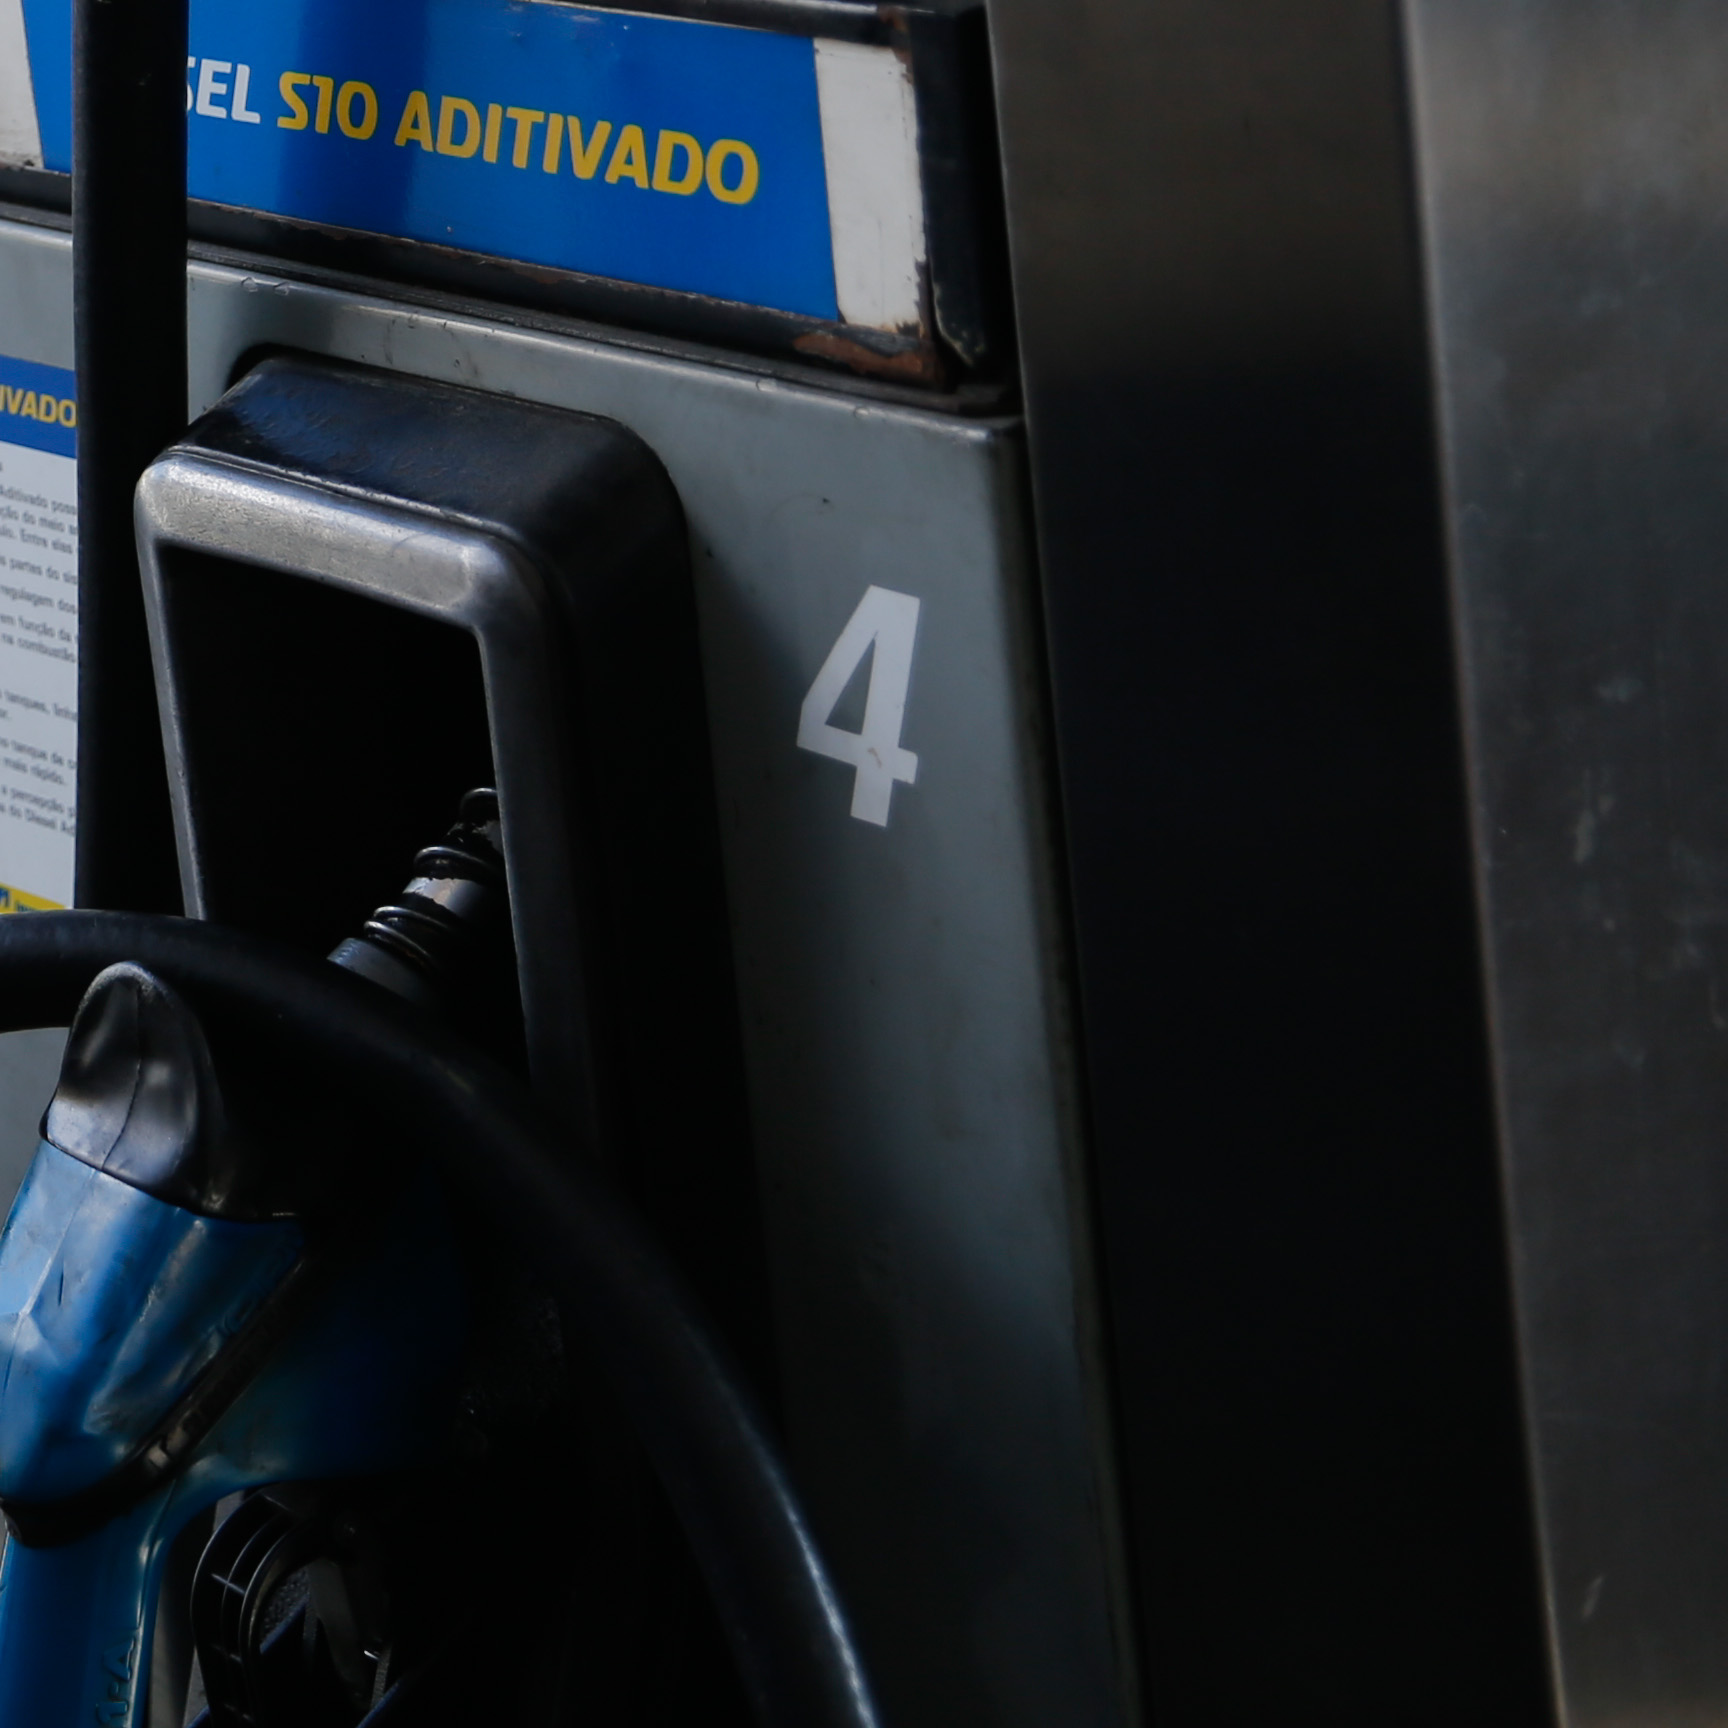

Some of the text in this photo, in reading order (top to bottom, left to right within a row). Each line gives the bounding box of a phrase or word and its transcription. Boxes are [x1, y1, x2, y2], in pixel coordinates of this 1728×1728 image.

[276, 70, 379, 142] S10
[394, 89, 760, 207] ADITIVADO
[796, 583, 921, 827] 4
